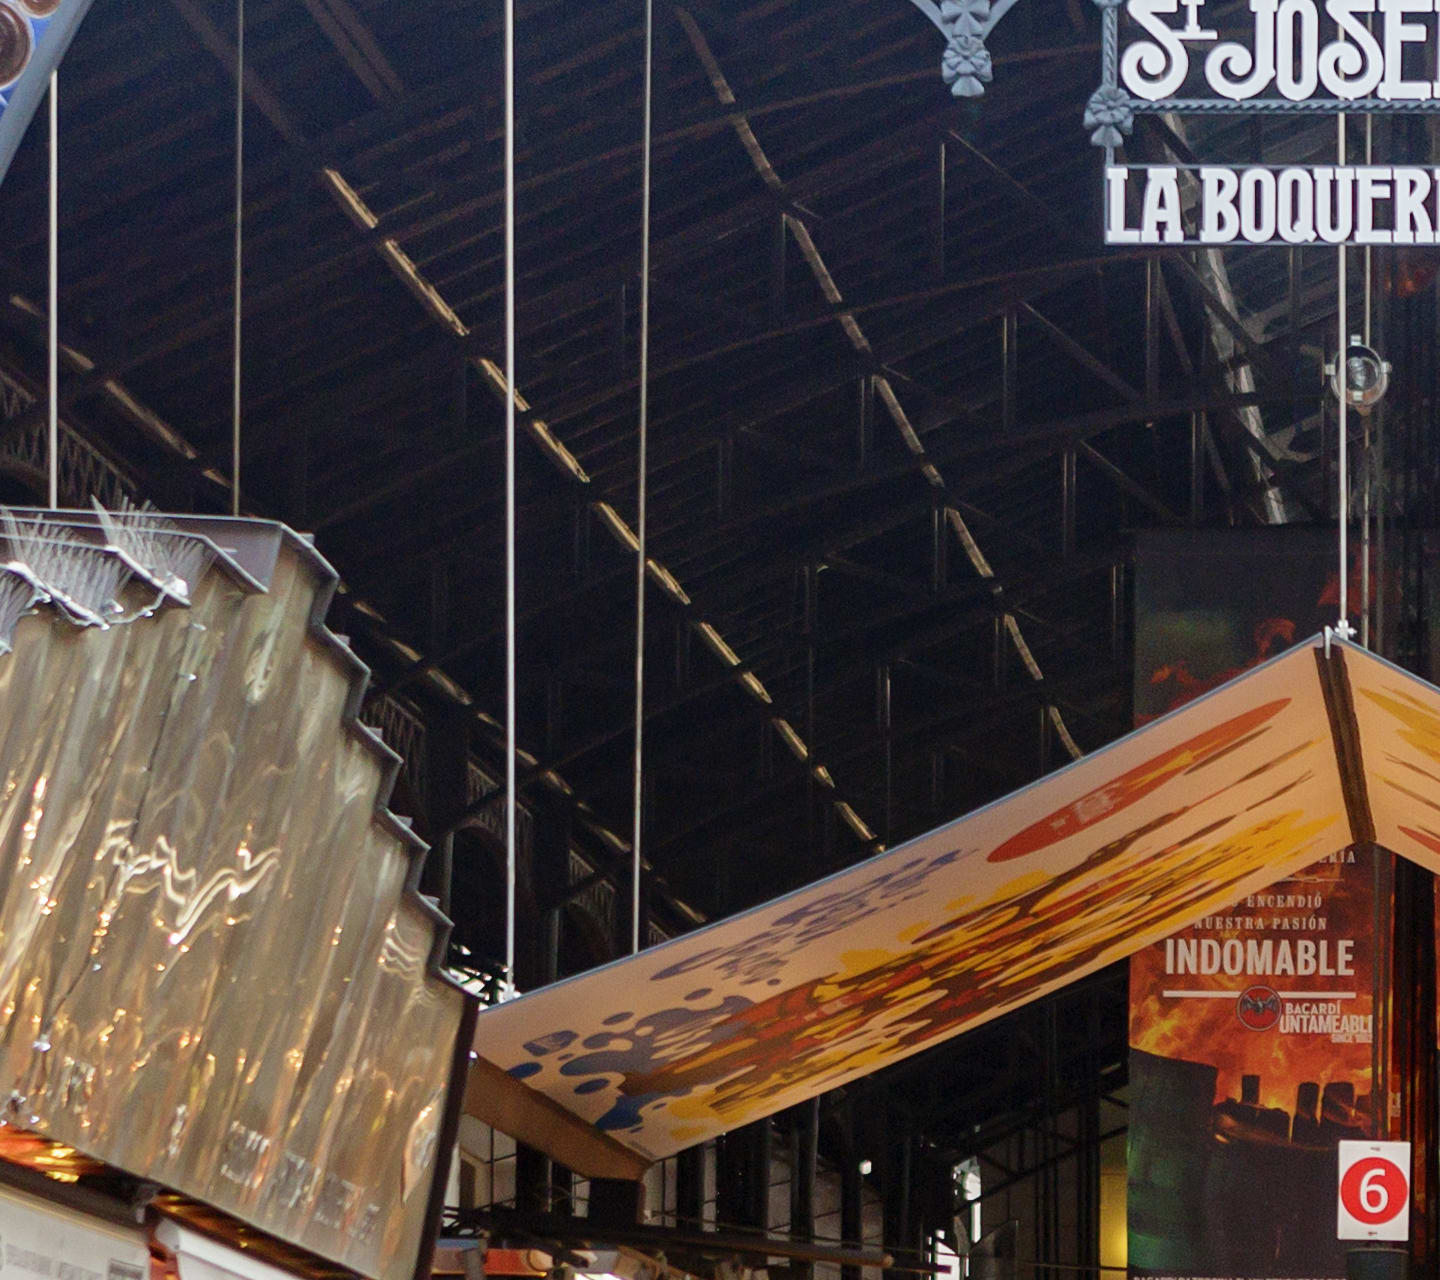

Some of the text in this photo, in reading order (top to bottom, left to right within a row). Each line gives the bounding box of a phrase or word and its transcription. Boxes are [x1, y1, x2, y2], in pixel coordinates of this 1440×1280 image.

[1106, 167, 1184, 243] LA
[1247, 893, 1322, 908] ENCENDIÓ
[1193, 915, 1327, 930] NUESTRA PASIÓN
[1166, 939, 1355, 976] INDOMABLE
[1280, 1014, 1373, 1033] UNTAMEABL
[1360, 1168, 1389, 1214] 6
